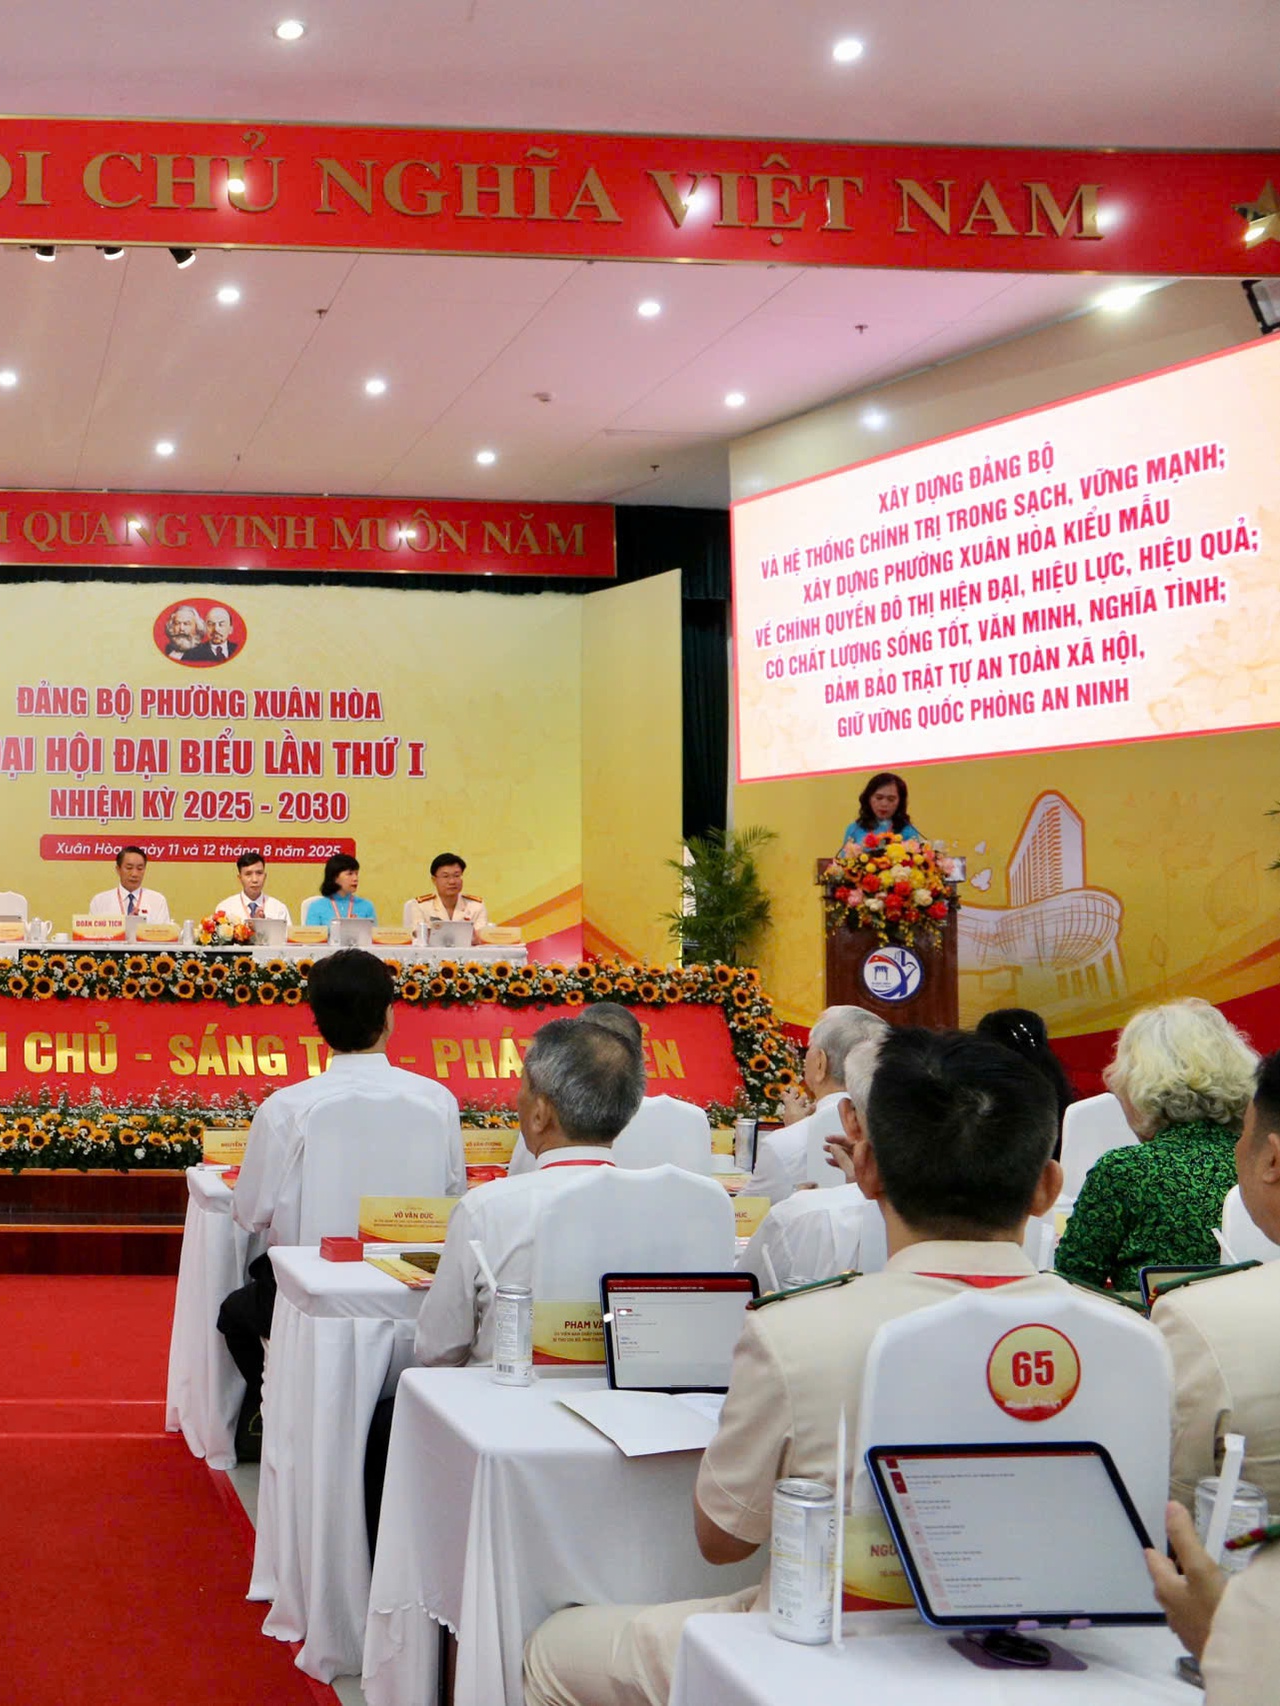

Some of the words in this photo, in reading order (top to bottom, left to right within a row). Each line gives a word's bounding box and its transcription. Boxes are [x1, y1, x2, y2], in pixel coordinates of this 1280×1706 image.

[83, 131, 285, 213] CHỦ
[314, 146, 624, 225] NGHĨA
[646, 153, 863, 247] VIỆT
[894, 177, 1105, 241] NAM
[879, 486, 909, 513] XÂY
[916, 471, 964, 504] DỰNG
[969, 455, 1021, 489] ĐẢNG
[1028, 441, 1054, 474] BỘ
[22, 511, 191, 553] QUANG
[199, 514, 317, 551] VINH
[329, 509, 469, 554] MUÔN
[481, 514, 588, 557] NĂM
[761, 558, 779, 579] VÀ
[783, 548, 800, 574] HỆ
[805, 538, 854, 568] THỐNG
[860, 523, 909, 555] CHÍNH
[914, 515, 941, 541] TRỊ
[947, 498, 1007, 533] TRONG
[1014, 482, 1073, 518] SẠCH,
[1079, 464, 1138, 500] VỮNG
[1146, 443, 1225, 484] MẠNH;
[804, 578, 831, 603] XÂY
[836, 568, 879, 598] DỰNG
[884, 550, 954, 585] PHƯỜNG
[959, 536, 1010, 568] XUÂN
[1017, 524, 1057, 556] HÒA
[1063, 506, 1111, 546] KIỂU
[1119, 494, 1170, 533] MẪU
[756, 624, 771, 648] VỀ
[776, 617, 820, 644] CHÍNH
[826, 601, 876, 635] QUYỀN
[881, 595, 902, 622] ĐÔ
[907, 592, 934, 618] THỊ
[940, 580, 982, 612] HIỆN
[988, 574, 1025, 604] ĐẠI,
[1032, 560, 1078, 594] HIỆU
[1085, 552, 1132, 584] LỰC,
[1139, 536, 1192, 572] HIỆU
[1201, 517, 1259, 561] QUẢ;
[766, 657, 784, 679] CÓ
[789, 650, 825, 675] CHẤT
[830, 640, 882, 672] LƯỢNG
[887, 630, 933, 658] SỐNG
[938, 620, 972, 648] TỐT,
[978, 614, 1016, 642] VĂN
[1022, 603, 1082, 634] MINH,
[1089, 586, 1158, 623] NGHĨA
[1164, 576, 1226, 609] TÌNH;
[825, 676, 859, 704] ĐẢM
[865, 669, 897, 698] BẢO
[902, 664, 943, 693] TRẬT
[949, 659, 972, 688] TỰ
[977, 656, 1003, 681] AN
[1008, 645, 1060, 676] TOÀN
[1067, 637, 1095, 668] XÃ
[1102, 630, 1145, 665] HỘI,
[18, 681, 86, 715] ĐẢNG
[98, 686, 131, 720] BỘ
[142, 687, 245, 717] PHƯỜNG
[255, 687, 320, 718] XUÂN
[331, 689, 381, 719] HÒA
[838, 713, 864, 738] GIỮ
[868, 708, 912, 734] VỮNG
[918, 696, 964, 728] QUỐC
[970, 690, 1035, 721] PHÒNG
[1042, 686, 1069, 712] AN
[1076, 678, 1129, 708] NINH
[47, 733, 101, 777] HỘI
[115, 739, 167, 778] ĐẠI
[181, 729, 252, 774] BIỂU
[265, 730, 321, 774] LẦN
[333, 738, 398, 776] THỨ
[409, 743, 423, 776] I
[52, 786, 132, 822] NHIỆM
[143, 791, 174, 818] KỲ
[184, 791, 251, 819] 2025
[279, 792, 346, 820] 2030
[56, 842, 91, 855] Xuân
[168, 844, 179, 856] 11
[183, 845, 199, 856] và
[203, 844, 216, 856] 12
[263, 845, 272, 857] 8
[275, 845, 305, 858] năm
[307, 845, 341, 858] 2025
[23, 1021, 118, 1074] CHỦ
[168, 1023, 288, 1076] SÁNG
[564, 1320, 591, 1331] PHẠM
[1012, 1350, 1054, 1387] 65
